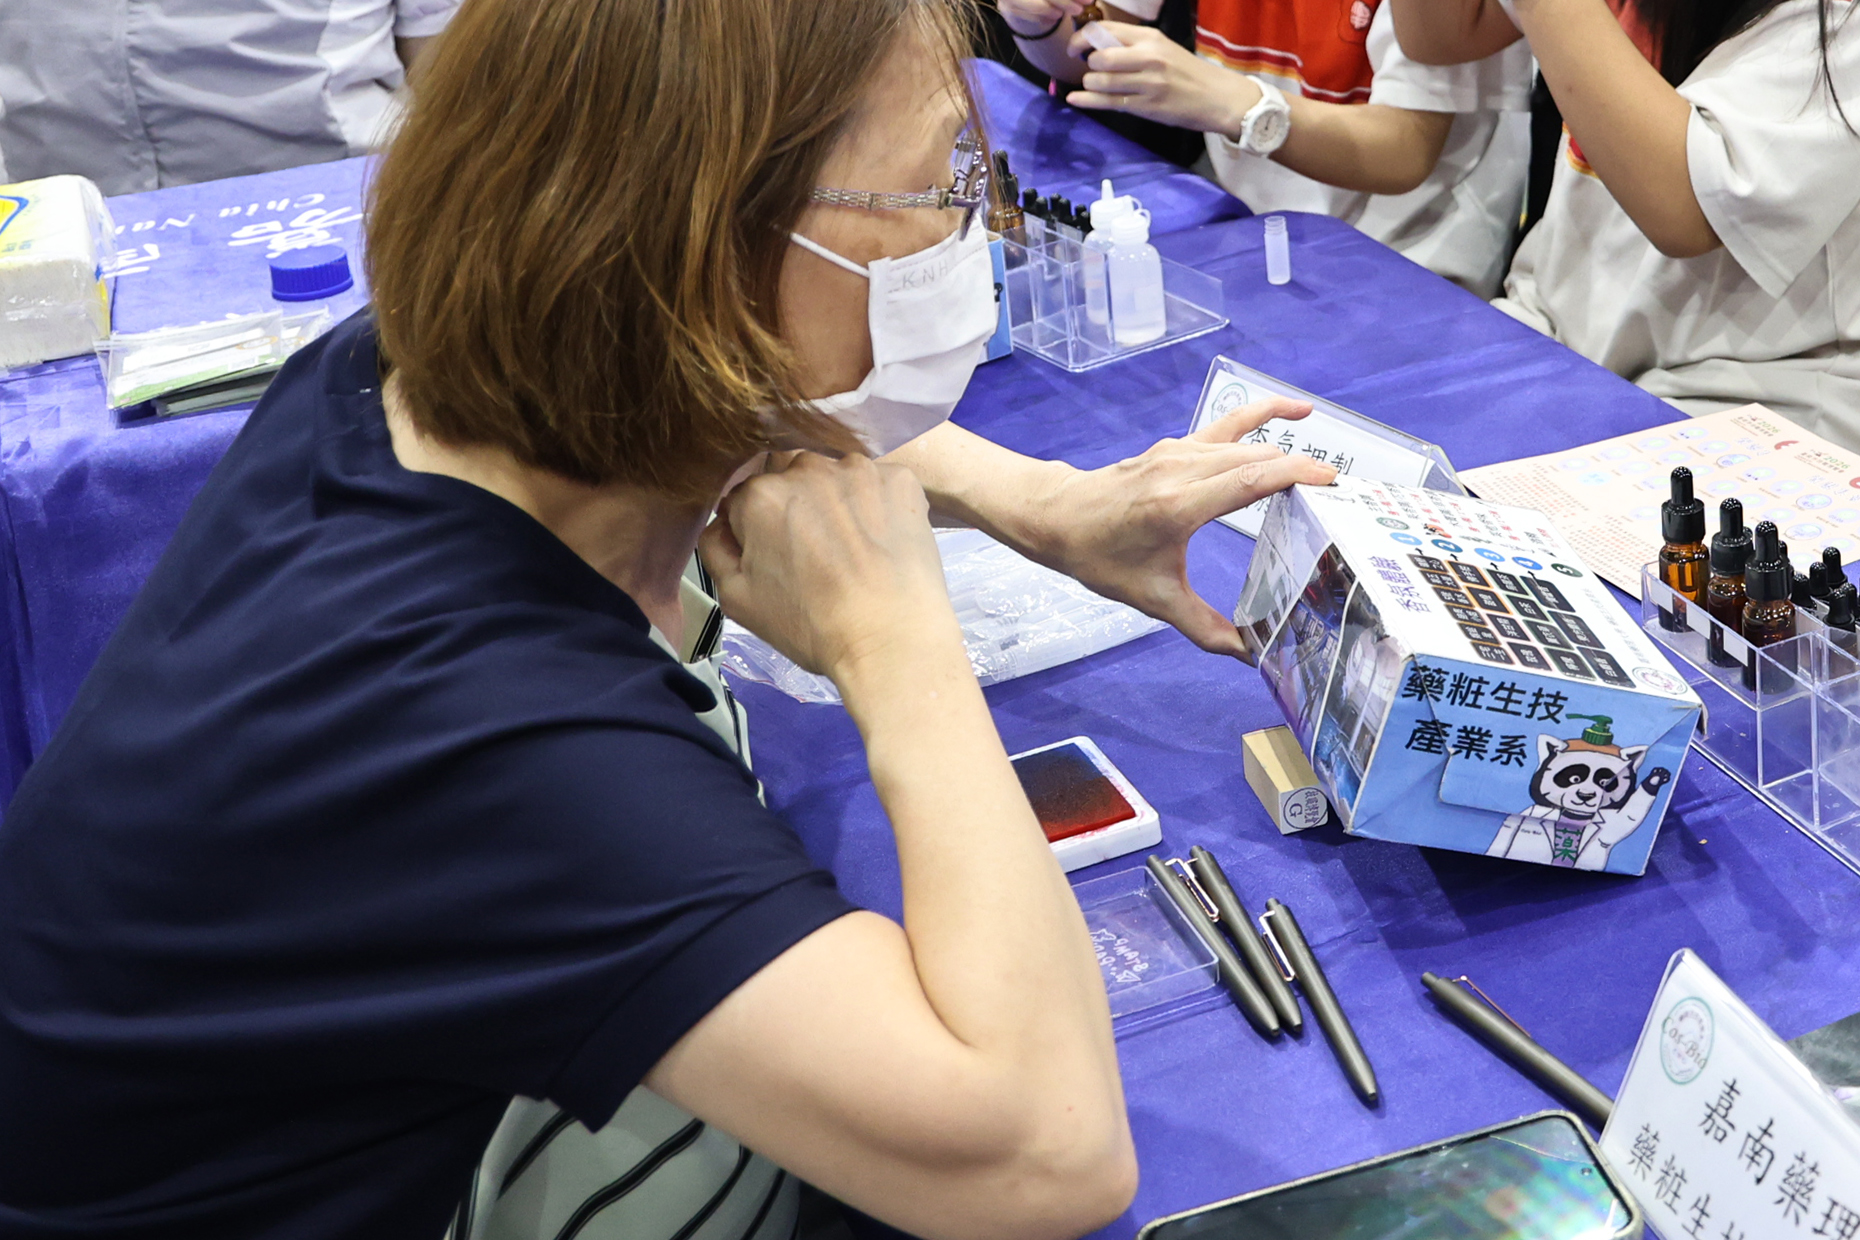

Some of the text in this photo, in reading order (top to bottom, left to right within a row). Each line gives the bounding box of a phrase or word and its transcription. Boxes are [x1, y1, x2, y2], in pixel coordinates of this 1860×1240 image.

[218, 192, 325, 219] Chia
[901, 259, 950, 289] KNH
[1401, 665, 1568, 725] 藥粧生技
[1405, 718, 1527, 768] 產業系
[1290, 803, 1303, 818] G
